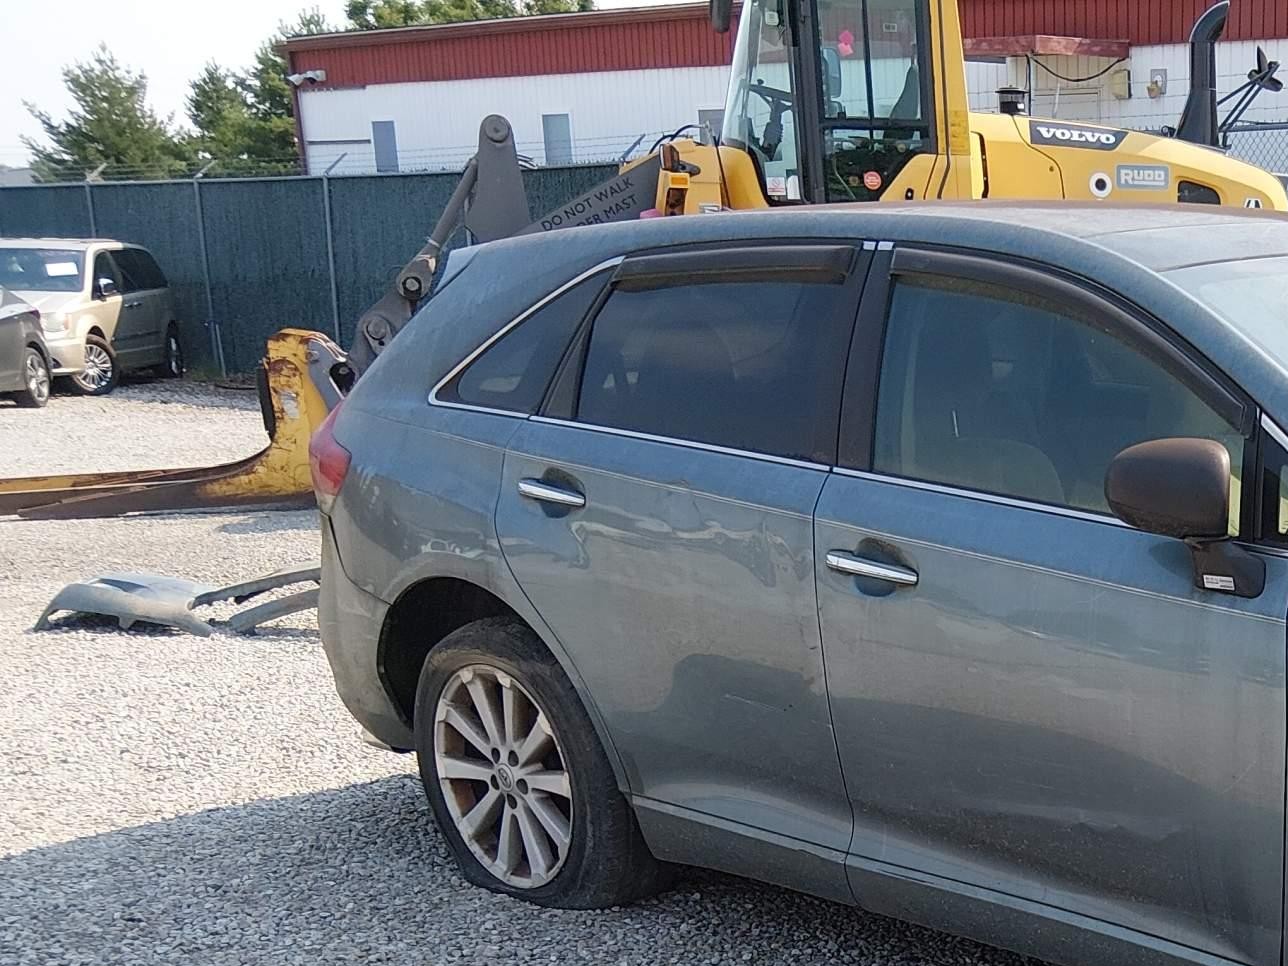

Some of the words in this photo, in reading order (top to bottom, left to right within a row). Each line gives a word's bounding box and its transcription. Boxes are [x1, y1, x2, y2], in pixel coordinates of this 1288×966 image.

[1036, 126, 1116, 144] VOLVO
[1120, 169, 1165, 185] RUDD
[541, 215, 562, 231] DO
[564, 197, 592, 219] NOT
[594, 178, 634, 202] WALK
[603, 194, 637, 219] MAST
